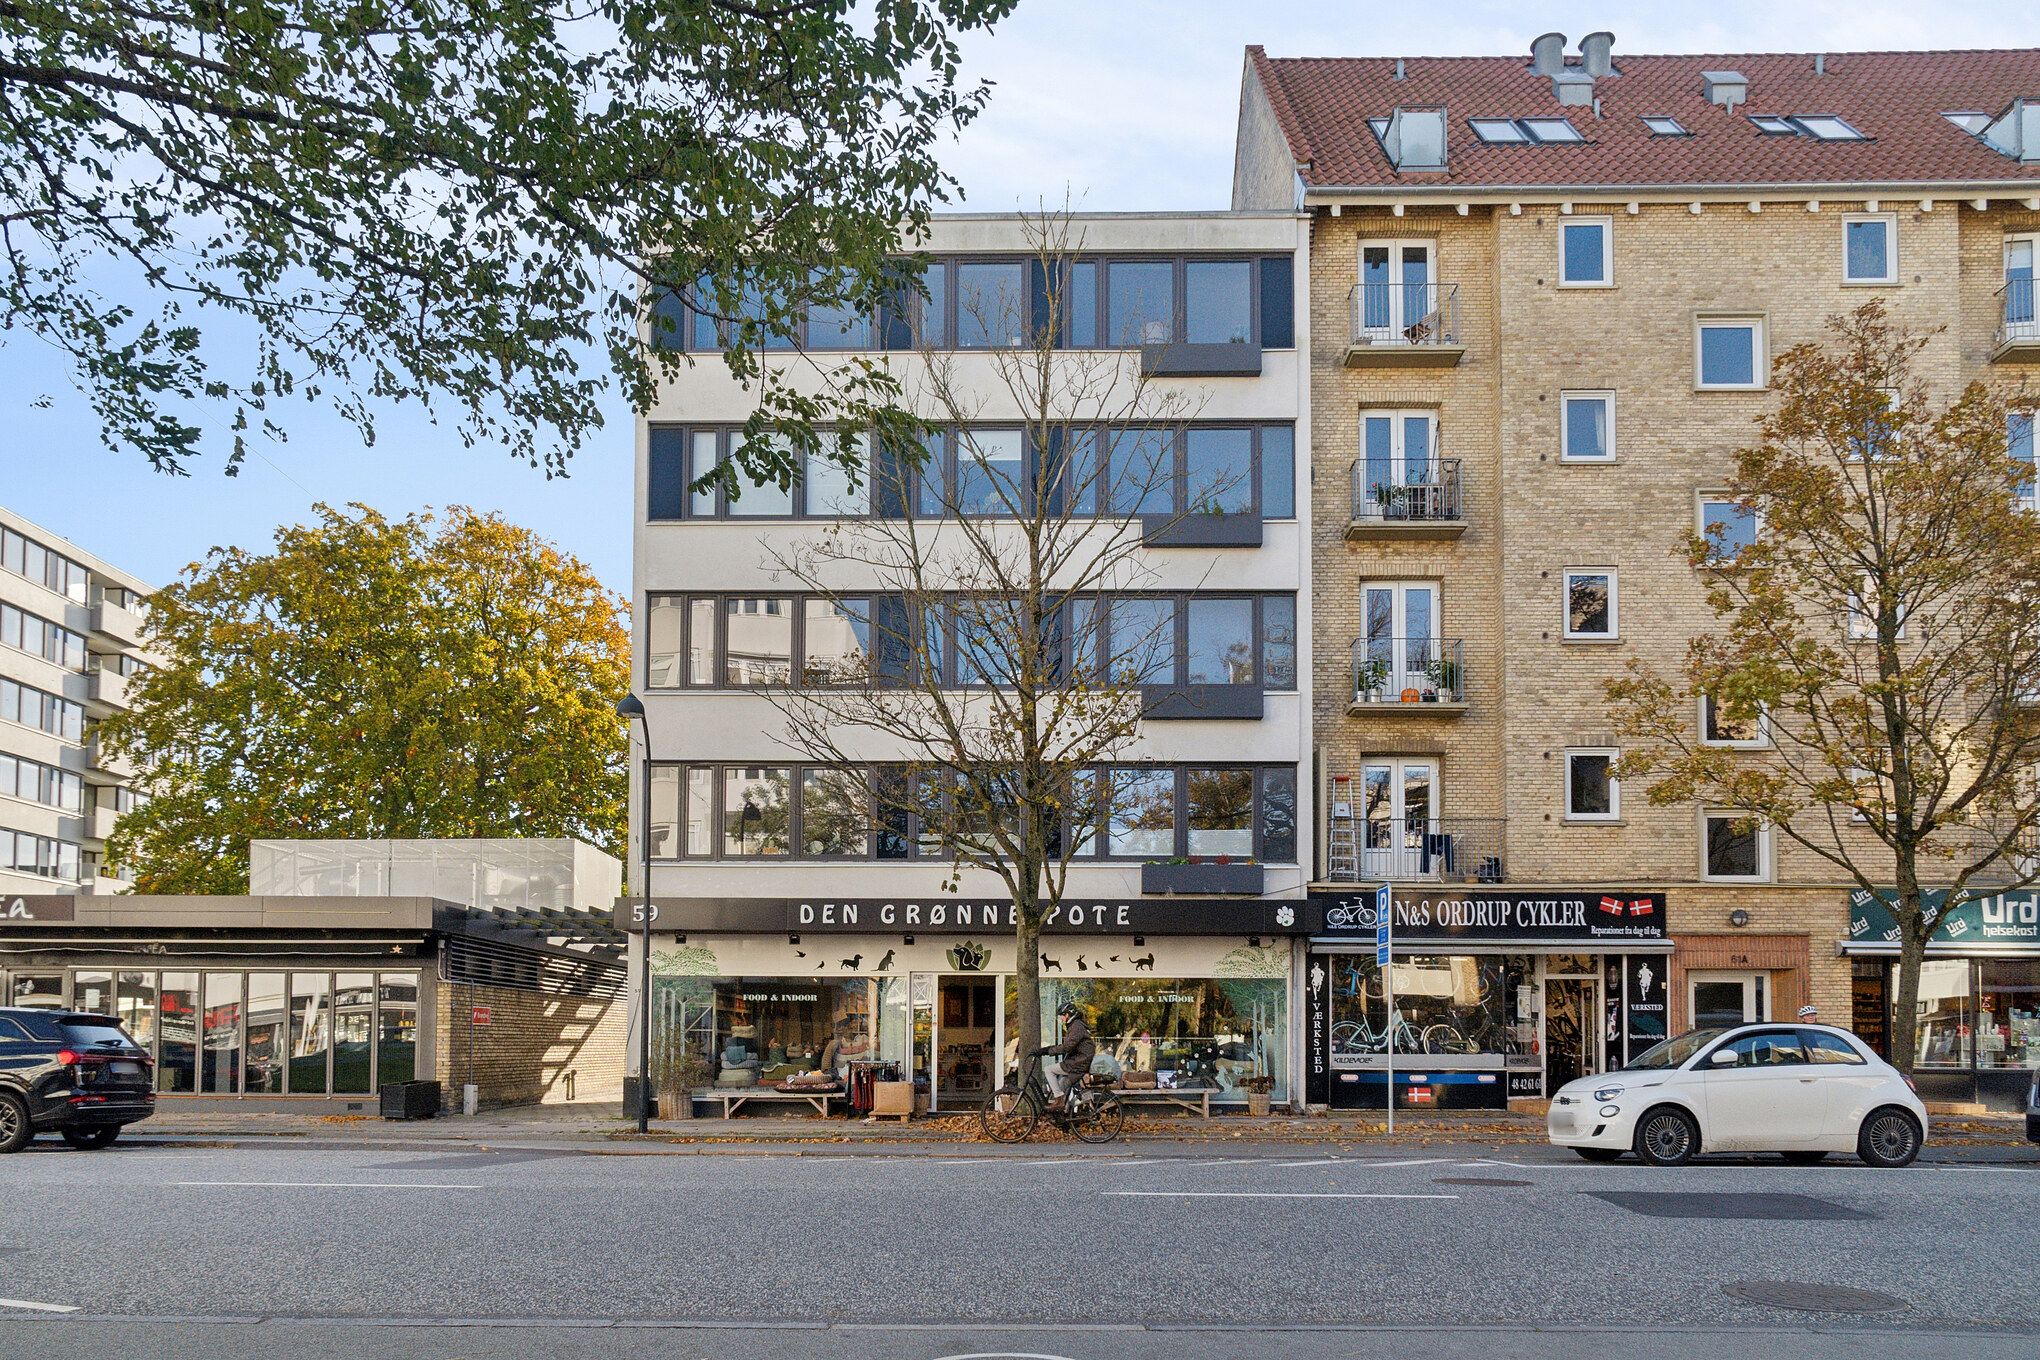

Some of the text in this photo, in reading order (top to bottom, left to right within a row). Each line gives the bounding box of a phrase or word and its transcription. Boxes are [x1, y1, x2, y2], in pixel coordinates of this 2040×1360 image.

[633, 905, 659, 922] 59
[800, 904, 858, 924] DEN
[1380, 892, 1387, 921] P
[1395, 900, 1587, 927] N&S ORDRUP CYKLER
[1981, 894, 2037, 923] Urd
[1591, 925, 1624, 937] Reparationer
[1633, 925, 1644, 938] dag
[1650, 925, 1661, 938] dag
[1945, 917, 1966, 934] Urd
[1983, 925, 2037, 937] helsekost
[743, 994, 818, 1002] FOOD & INDOOR
[1119, 995, 1194, 1003] FOOD & INDOOR
[1312, 1003, 1323, 1073] VÆRKSTED
[1511, 1078, 1519, 1090] 48
[1520, 1078, 1527, 1090] 42
